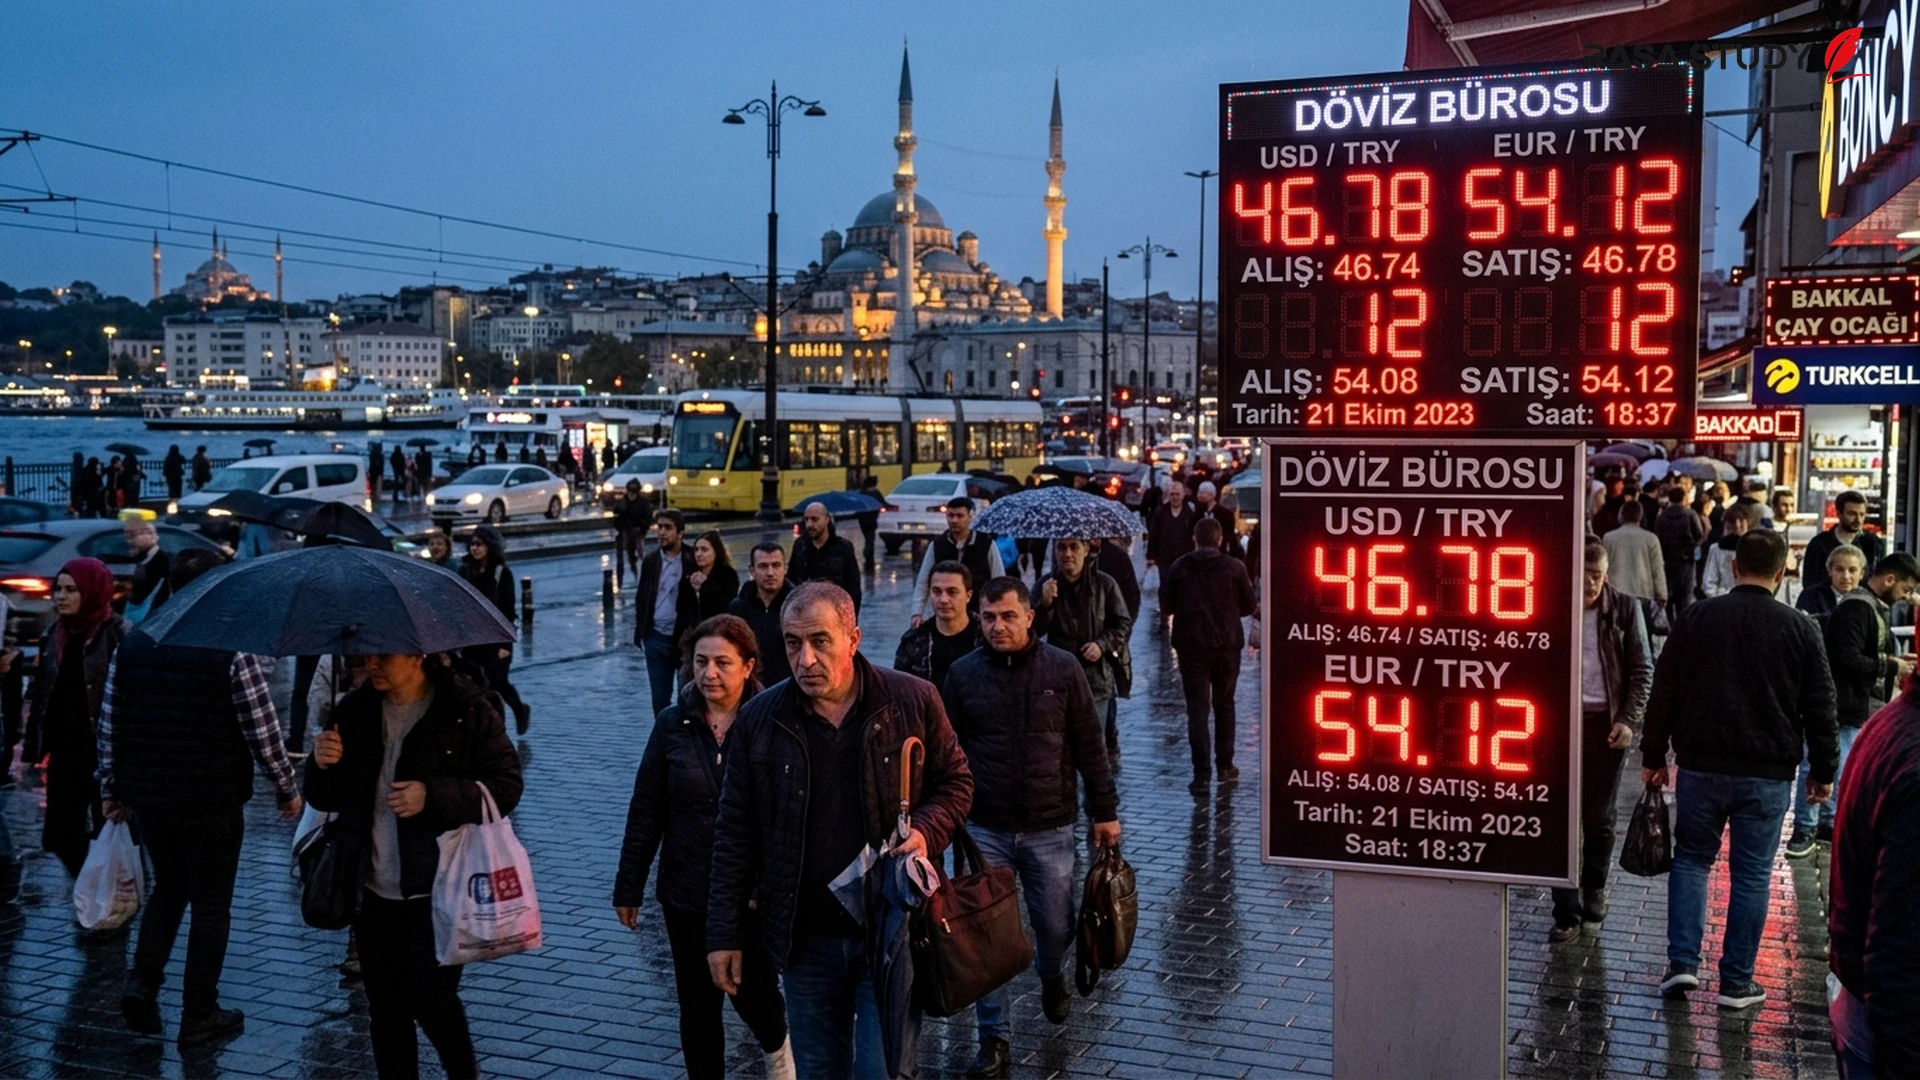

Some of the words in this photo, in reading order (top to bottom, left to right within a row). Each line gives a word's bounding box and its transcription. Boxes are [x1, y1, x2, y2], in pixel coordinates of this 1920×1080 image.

[1295, 86, 1416, 131] DÖVİZ
[1430, 79, 1610, 123] BÜROSU
[1260, 143, 1318, 168] USD
[1326, 143, 1334, 166] /
[1344, 140, 1400, 165] TRY
[1494, 132, 1557, 157] EUR
[1566, 130, 1575, 154] /
[1584, 126, 1646, 152] TRY
[1235, 171, 1430, 246] 46.78
[1465, 160, 1678, 240] 54.12
[1241, 256, 1323, 287] ALIŞ:
[1333, 253, 1420, 281] 46.74
[1462, 248, 1572, 281] SATIŞ:
[1583, 244, 1676, 273] 46.78
[1791, 288, 1892, 308] BAKKAL
[1369, 288, 1426, 358] 12
[1610, 282, 1674, 355] 12
[1775, 318, 1823, 340] ÇAY
[1830, 312, 1907, 336] OCAĞI
[1240, 369, 1322, 399] ALIŞ:
[1333, 368, 1418, 394] 54.08
[1460, 366, 1570, 398] SATIŞ:
[1582, 365, 1674, 393] 54.12
[1805, 366, 1920, 385] TURKCELL
[1232, 403, 1299, 425] Tarih:
[1307, 403, 1338, 425] 21
[1344, 403, 1407, 425] Ekim
[1413, 403, 1475, 425] 2023
[1526, 403, 1594, 426] Saat:
[1604, 402, 1676, 425] 18:37
[1696, 416, 1774, 434] BAKKAD
[1280, 450, 1390, 487] DÖVİZ
[1403, 450, 1563, 488] BÜROSU
[1325, 506, 1402, 536] USD
[1413, 507, 1425, 537] /
[1436, 508, 1512, 538] TRY
[1315, 544, 1534, 619] 46.78
[1288, 624, 1341, 646] ALIŞ:
[1348, 626, 1401, 644] 46.74
[1406, 627, 1414, 645] /
[1419, 628, 1488, 651] SATIŞ:
[1494, 631, 1550, 650] 46.78
[1325, 655, 1401, 685] EUR
[1412, 658, 1424, 686] /
[1434, 659, 1511, 689] TRY
[1315, 691, 1534, 771] 54.12
[1288, 770, 1340, 793] ALIŞ:
[1347, 773, 1400, 792] 54.08
[1405, 776, 1413, 793] /
[1418, 777, 1486, 801] SATIŞ:
[1494, 783, 1549, 802] 54.12
[1294, 801, 1363, 825] Tarih:
[1372, 806, 1398, 828] 21
[1410, 808, 1473, 833] Ekim
[1481, 813, 1541, 837] 2023
[1345, 833, 1408, 858] Saat:
[1418, 840, 1487, 863] 18:37
